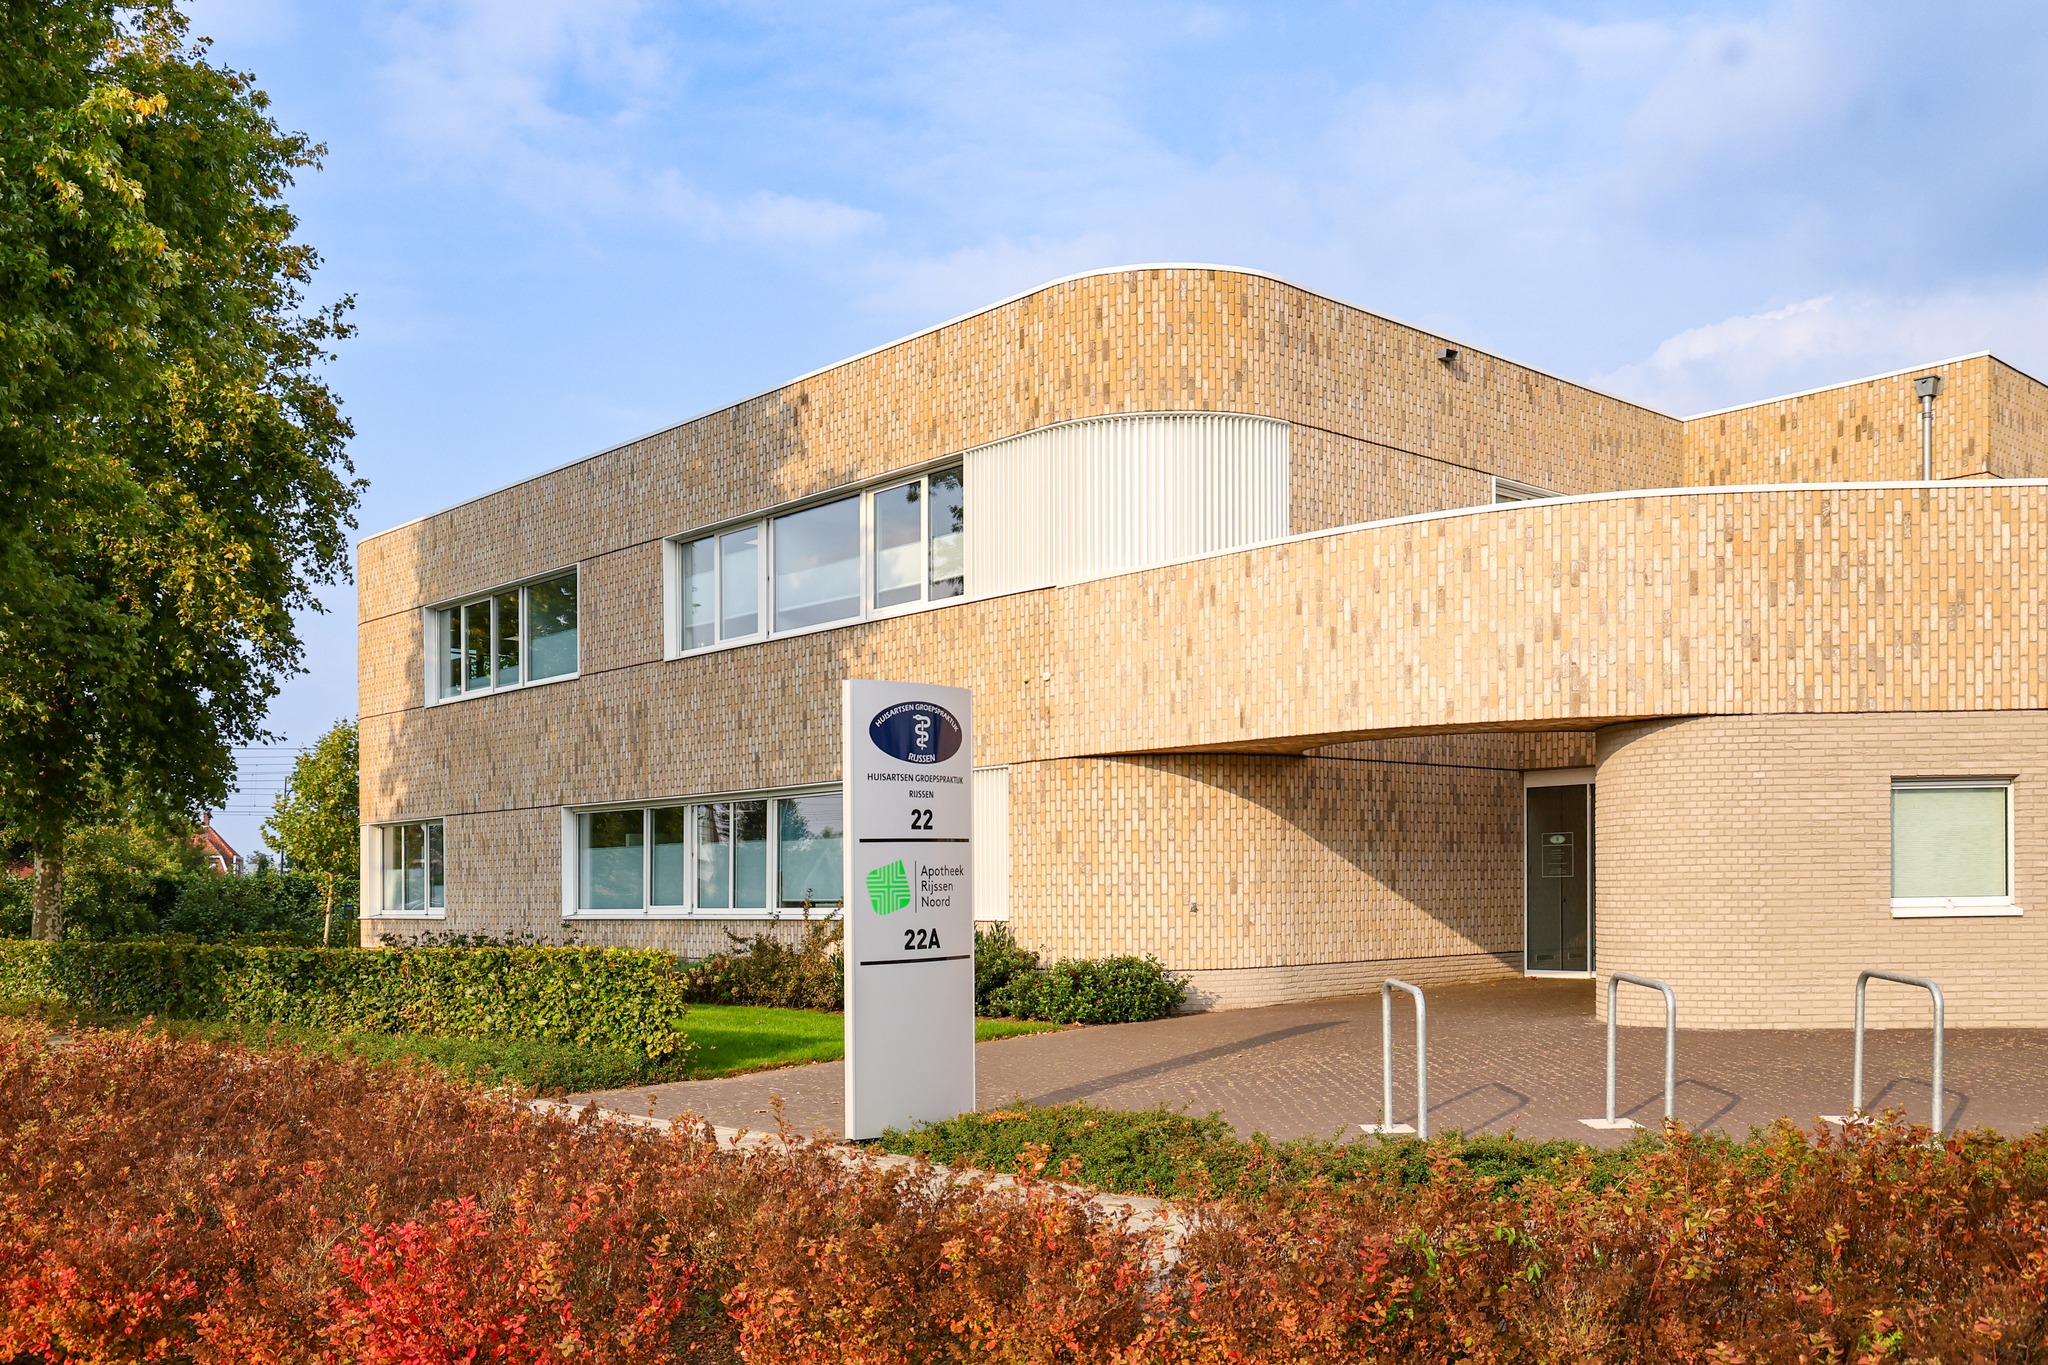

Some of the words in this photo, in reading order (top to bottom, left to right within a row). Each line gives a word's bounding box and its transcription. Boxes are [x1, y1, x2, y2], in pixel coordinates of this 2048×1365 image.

[867, 772, 914, 782] HUISARTSEN
[909, 790, 934, 798] RIJSSEN
[911, 809, 933, 830] 22
[921, 865, 964, 879] Apotheek
[921, 880, 953, 895] Rijssen
[921, 895, 951, 907] Noord
[904, 928, 941, 950] 22A
